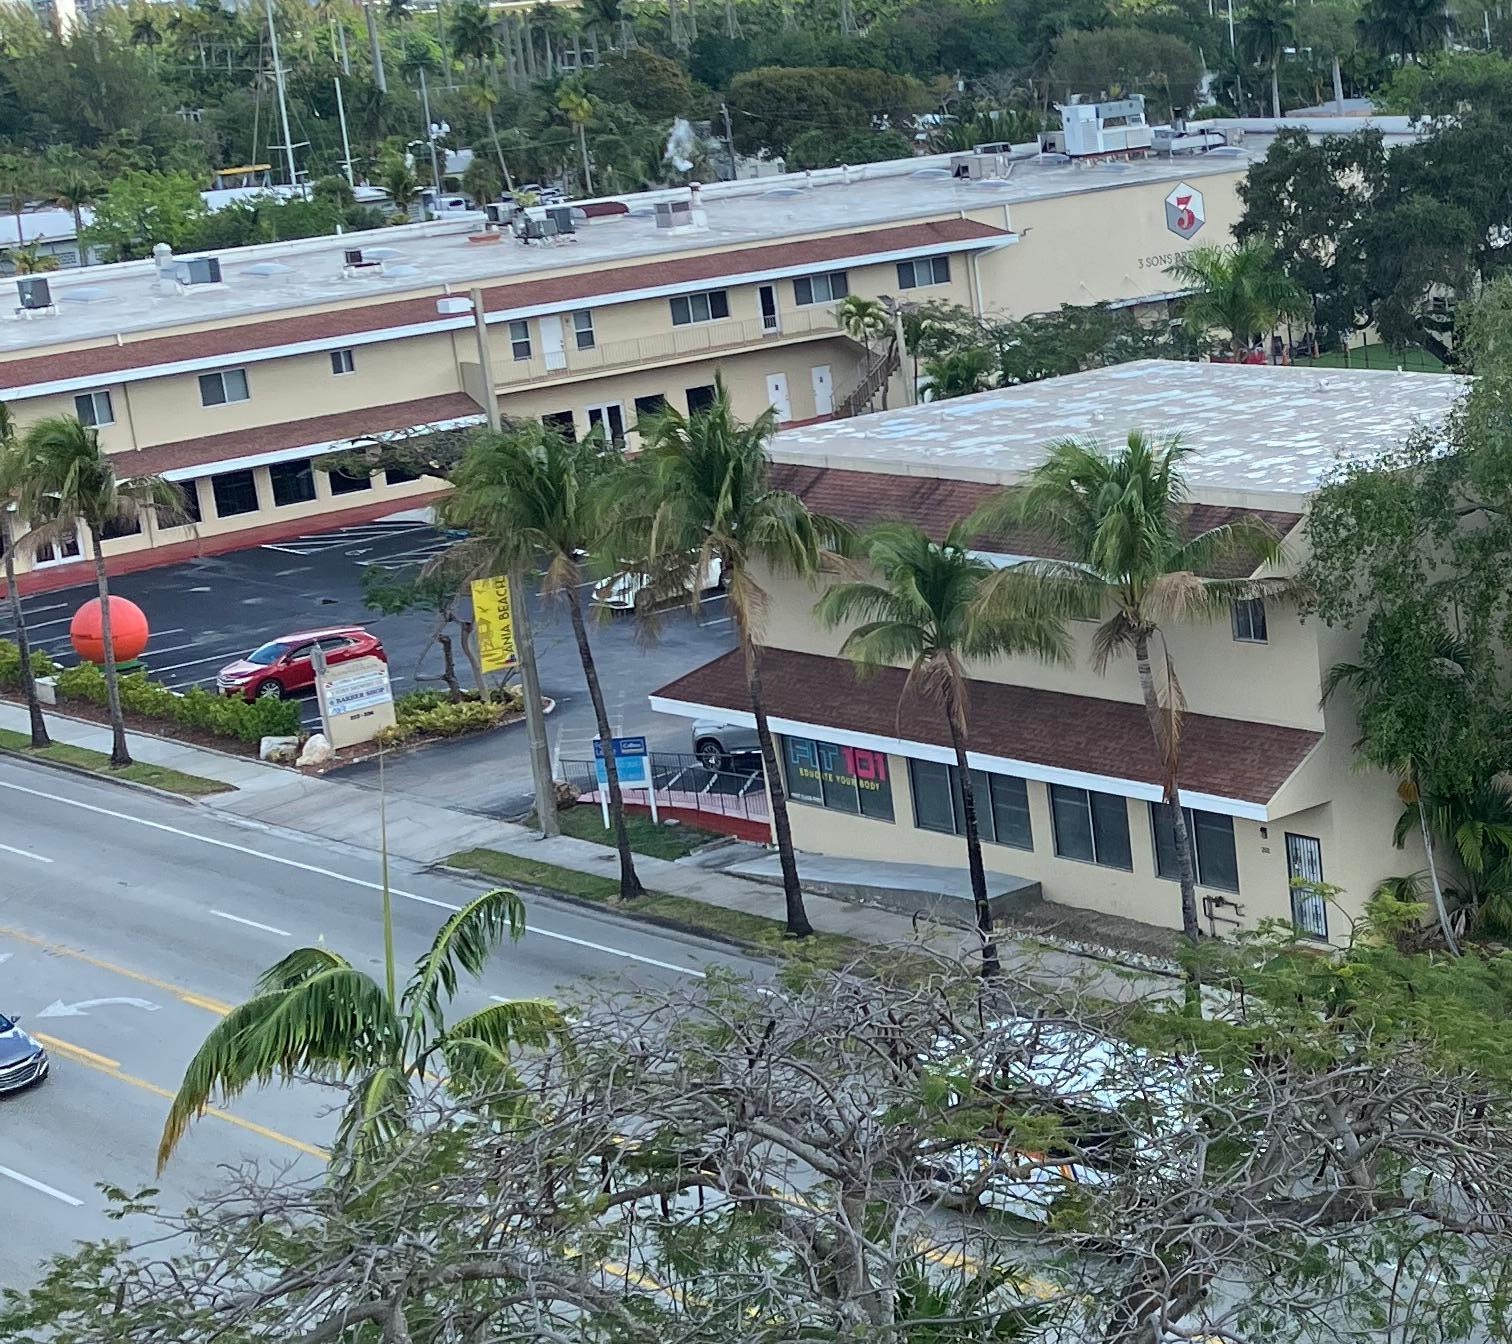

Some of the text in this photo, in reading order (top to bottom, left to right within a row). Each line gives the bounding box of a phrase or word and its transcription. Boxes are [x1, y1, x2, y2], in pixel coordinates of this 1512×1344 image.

[1176, 194, 1195, 231] 3
[1137, 258, 1144, 270] 3
[1145, 253, 1173, 268] SONS
[789, 738, 886, 781] FIT 101
